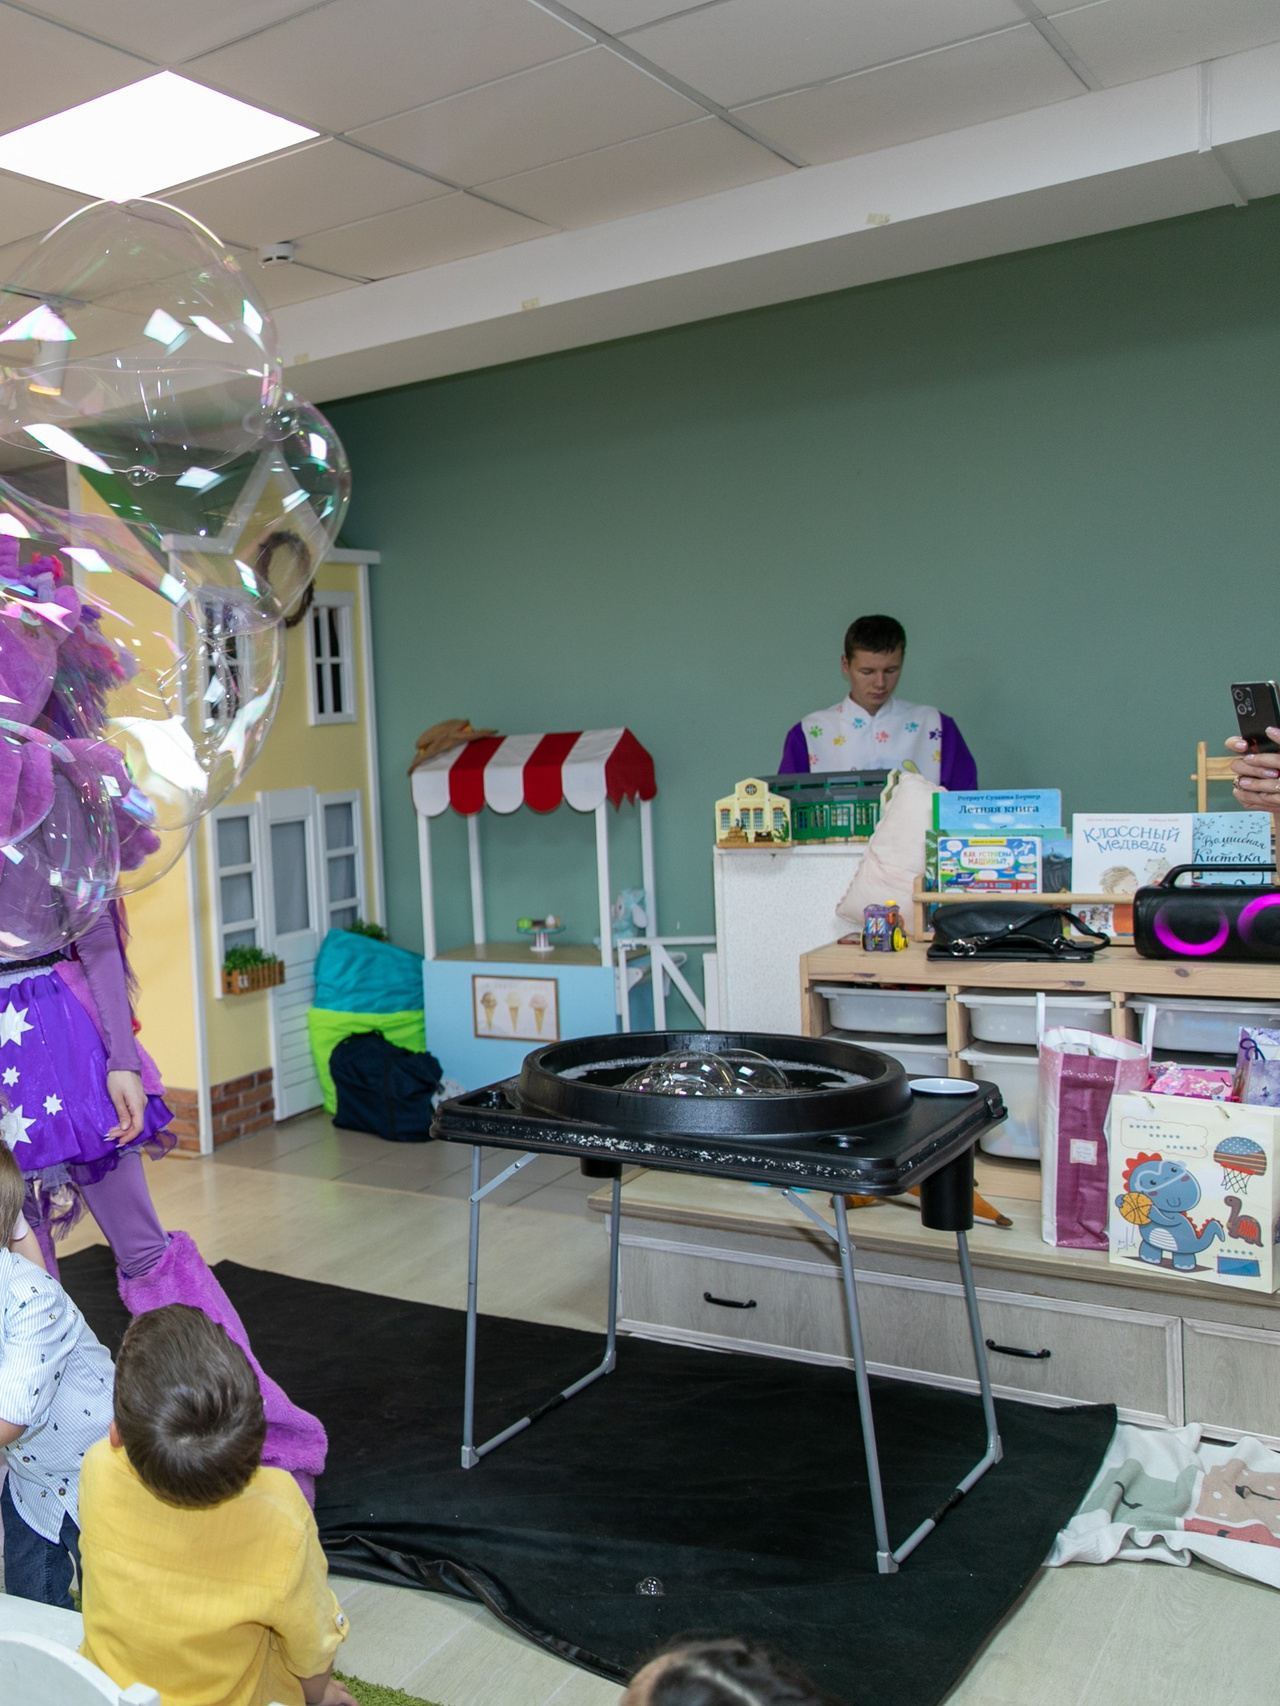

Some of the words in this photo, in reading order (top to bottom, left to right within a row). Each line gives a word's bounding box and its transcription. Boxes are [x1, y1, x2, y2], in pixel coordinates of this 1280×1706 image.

[958, 805, 1000, 815] Летняя
[1004, 804, 1040, 813] книга
[968, 858, 1007, 866] МАШИНЫ?
